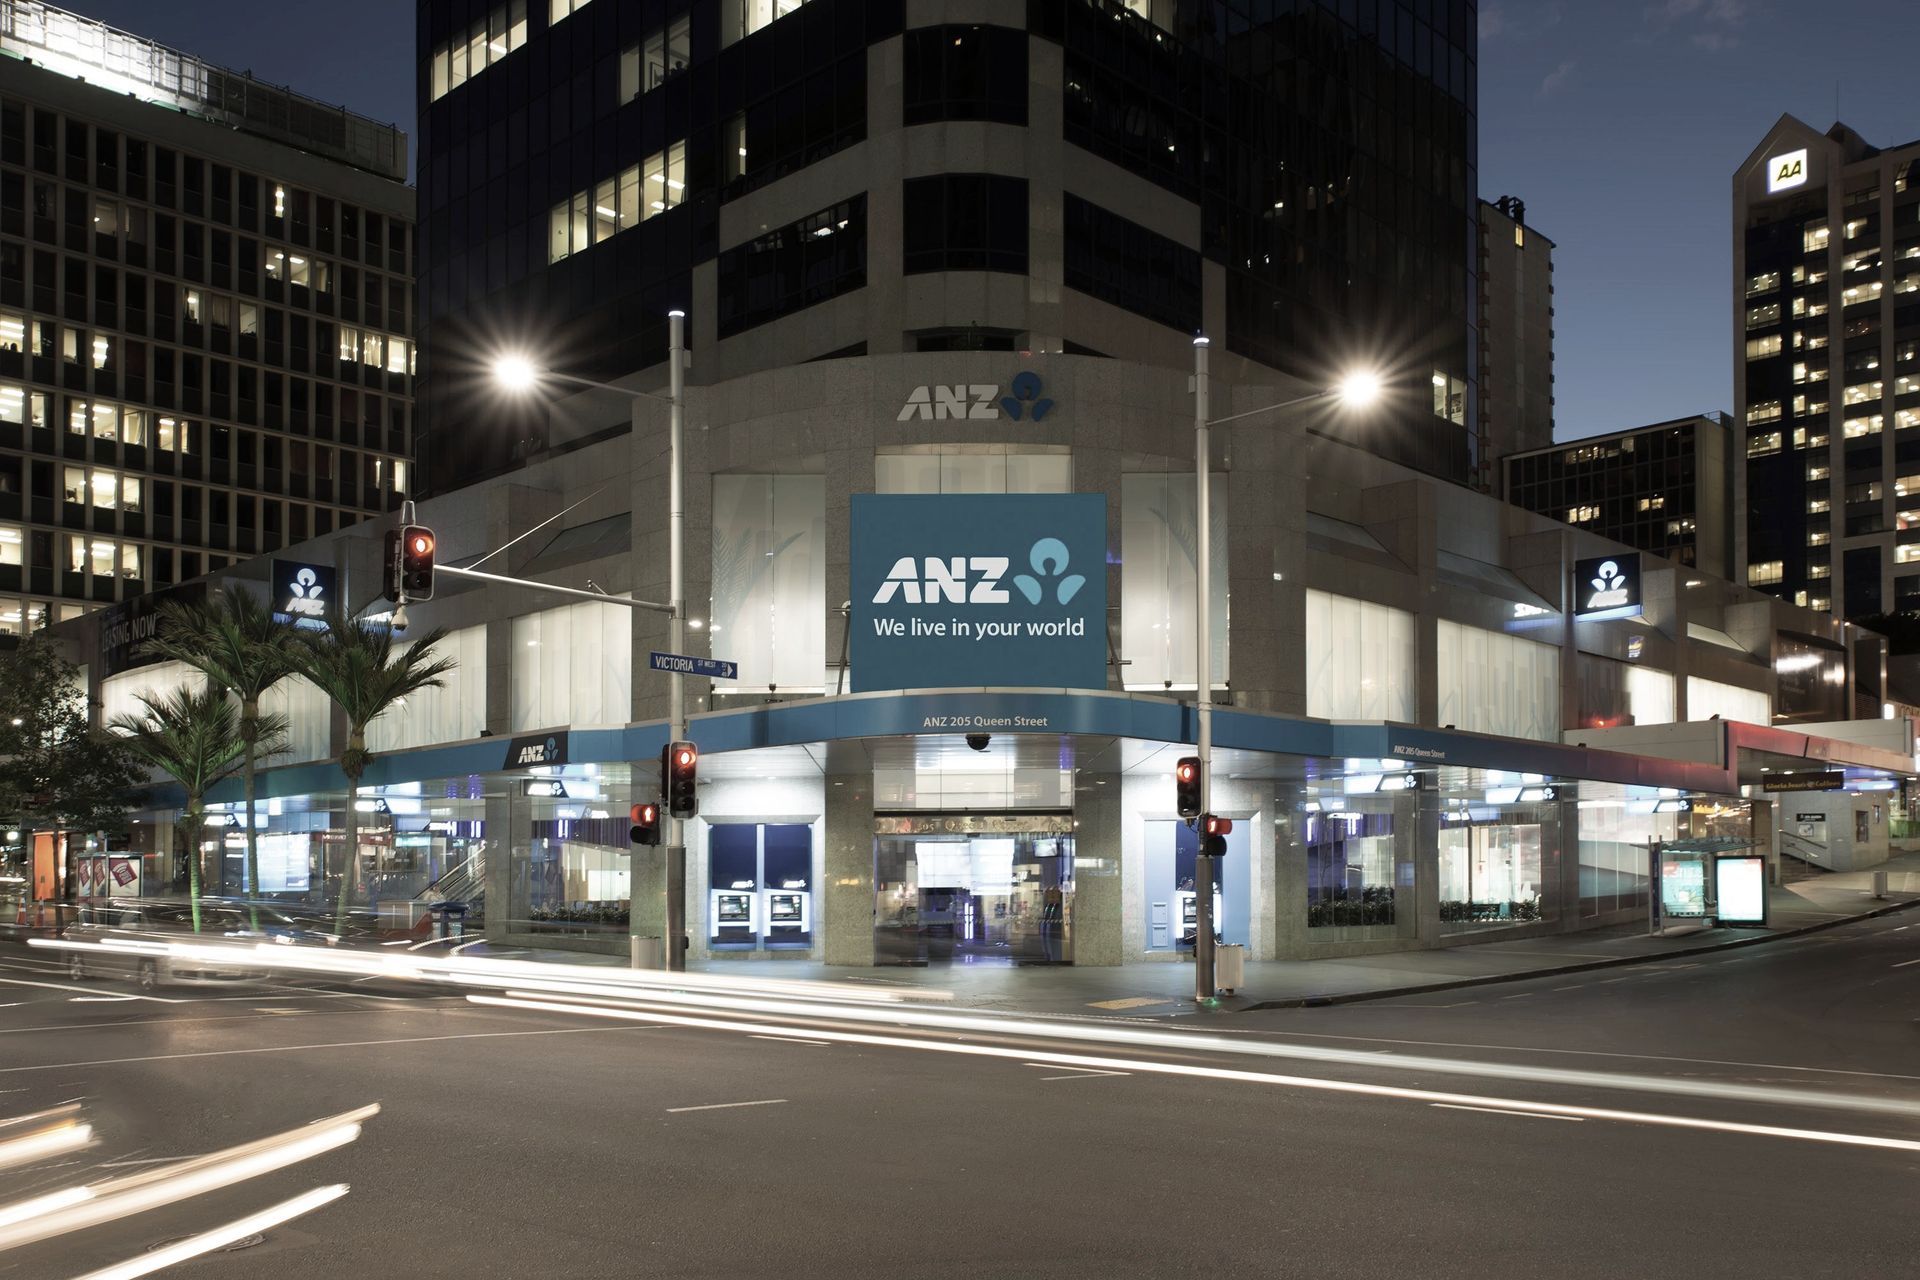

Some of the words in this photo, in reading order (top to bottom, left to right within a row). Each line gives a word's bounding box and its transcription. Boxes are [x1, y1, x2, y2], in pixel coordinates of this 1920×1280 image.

[1777, 160, 1801, 181] AA
[897, 384, 999, 421] ANZ
[872, 557, 1010, 604] ANZ
[132, 613, 157, 641] NOW
[873, 618, 905, 636] We
[911, 617, 946, 636] live
[952, 617, 970, 636] in
[975, 622, 1021, 641] your
[1027, 617, 1084, 636] world
[655, 655, 694, 672] VICTORIA
[924, 716, 947, 727] ANZ
[950, 716, 971, 727] 205
[974, 716, 1012, 727] Queen
[1014, 716, 1048, 727] Street
[518, 744, 544, 764] ANZ
